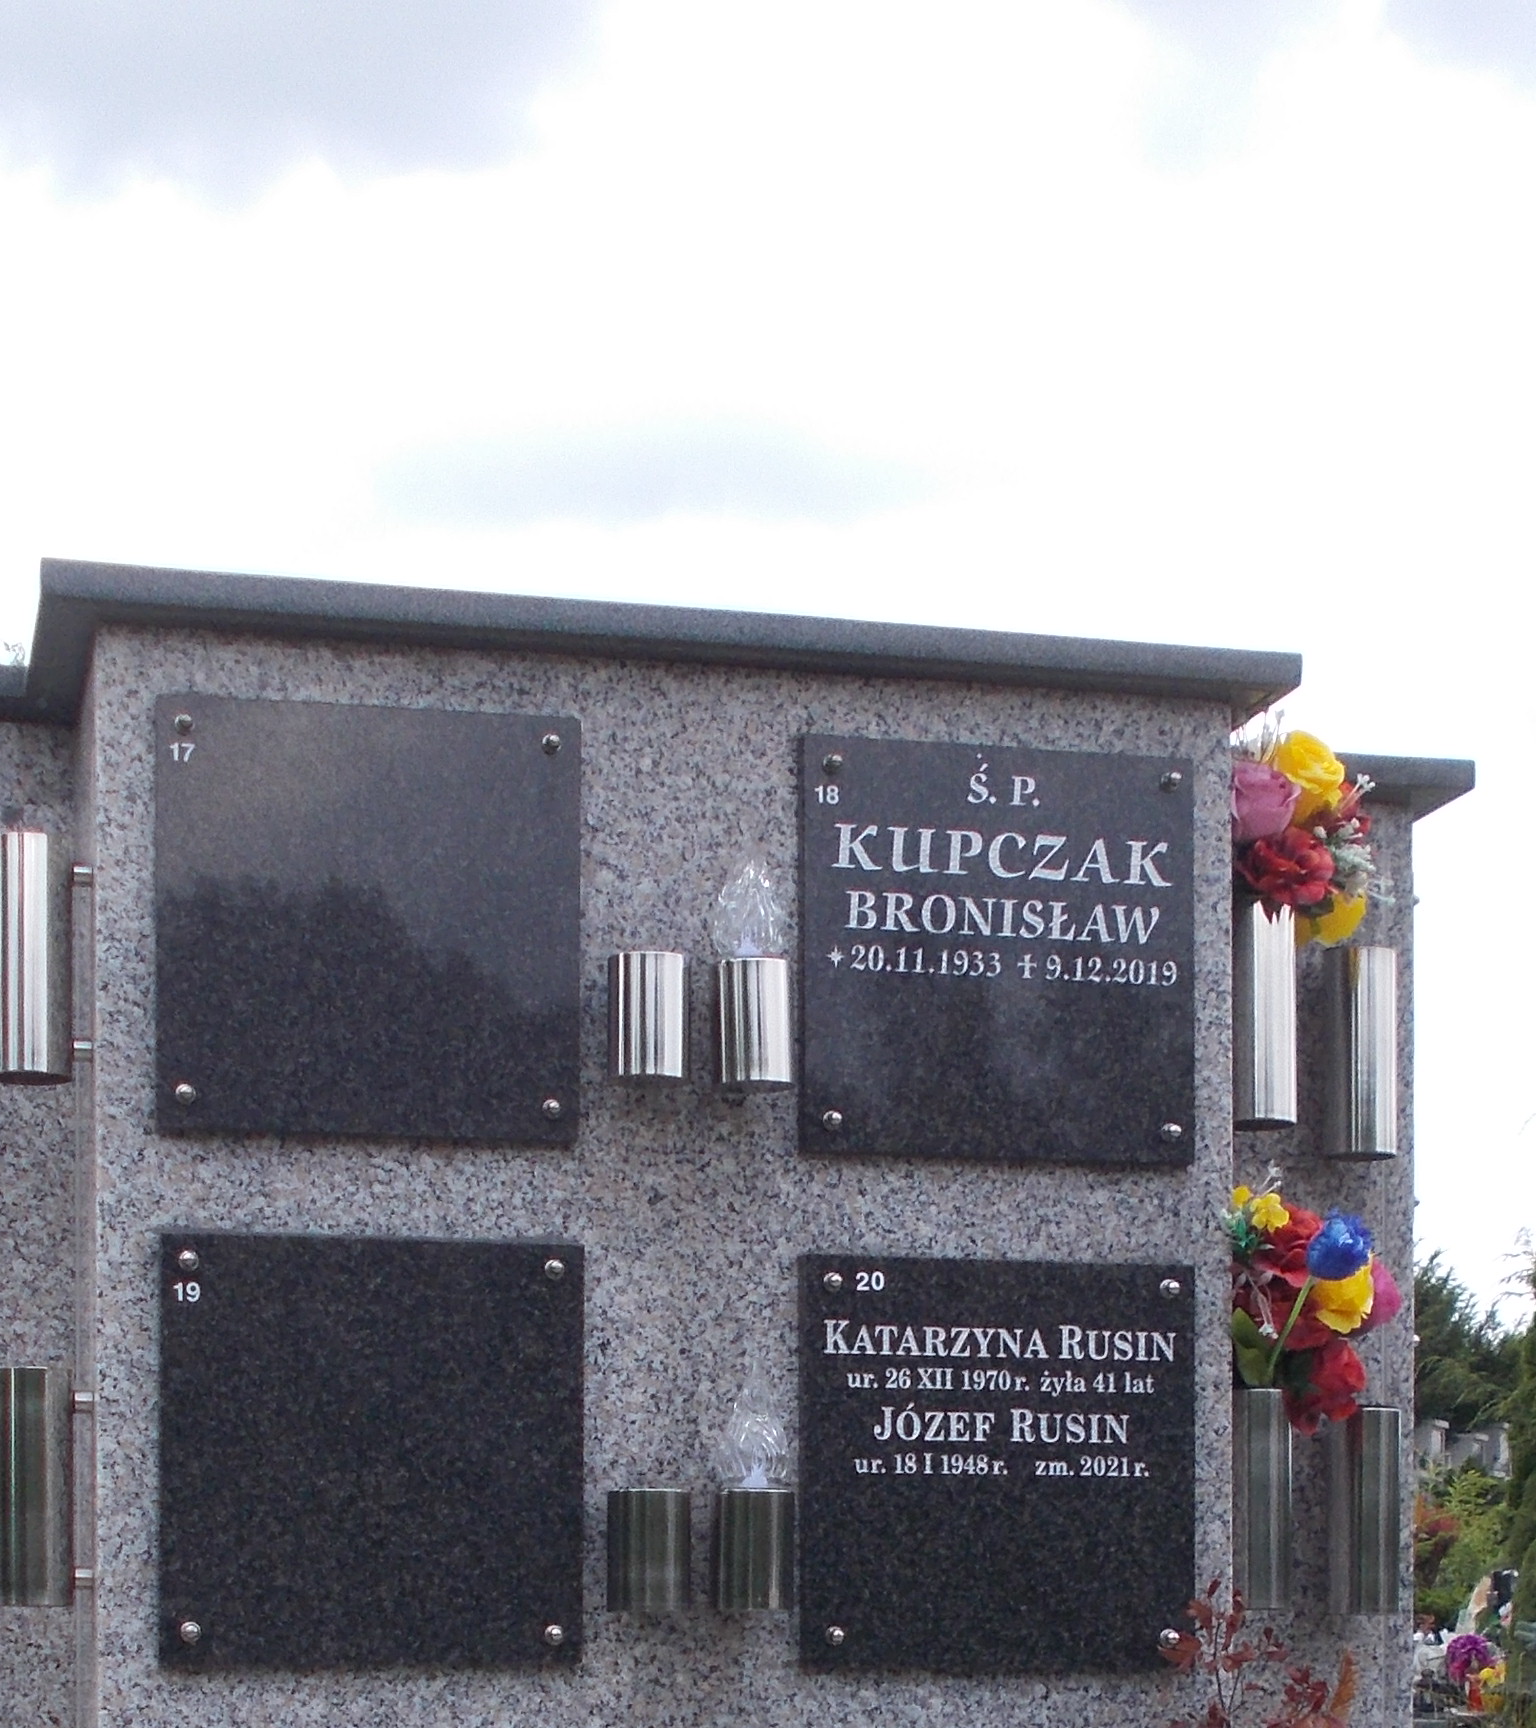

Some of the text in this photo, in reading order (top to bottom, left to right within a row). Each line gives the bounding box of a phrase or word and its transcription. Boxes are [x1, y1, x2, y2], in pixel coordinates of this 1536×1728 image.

[169, 742, 195, 763] 17
[814, 785, 839, 805] 18
[831, 823, 1173, 887] KUPCZAK
[844, 890, 1160, 945] BRONISŁAW
[173, 1281, 201, 1303] 19
[855, 1270, 885, 1291] 20
[823, 1319, 1177, 1362] KATARZYNA RUSIN
[846, 1372, 879, 1389] ur.
[885, 1367, 912, 1389] 26
[917, 1367, 954, 1390] XII
[1040, 1370, 1087, 1397] żyła
[1092, 1372, 1117, 1393] 41
[1124, 1371, 1155, 1394] lat
[873, 1402, 1130, 1444] JÓZEF RUSIN
[853, 1458, 887, 1474] ur.
[894, 1452, 917, 1474] 18
[923, 1452, 934, 1474] I
[1035, 1460, 1075, 1476] zm.
